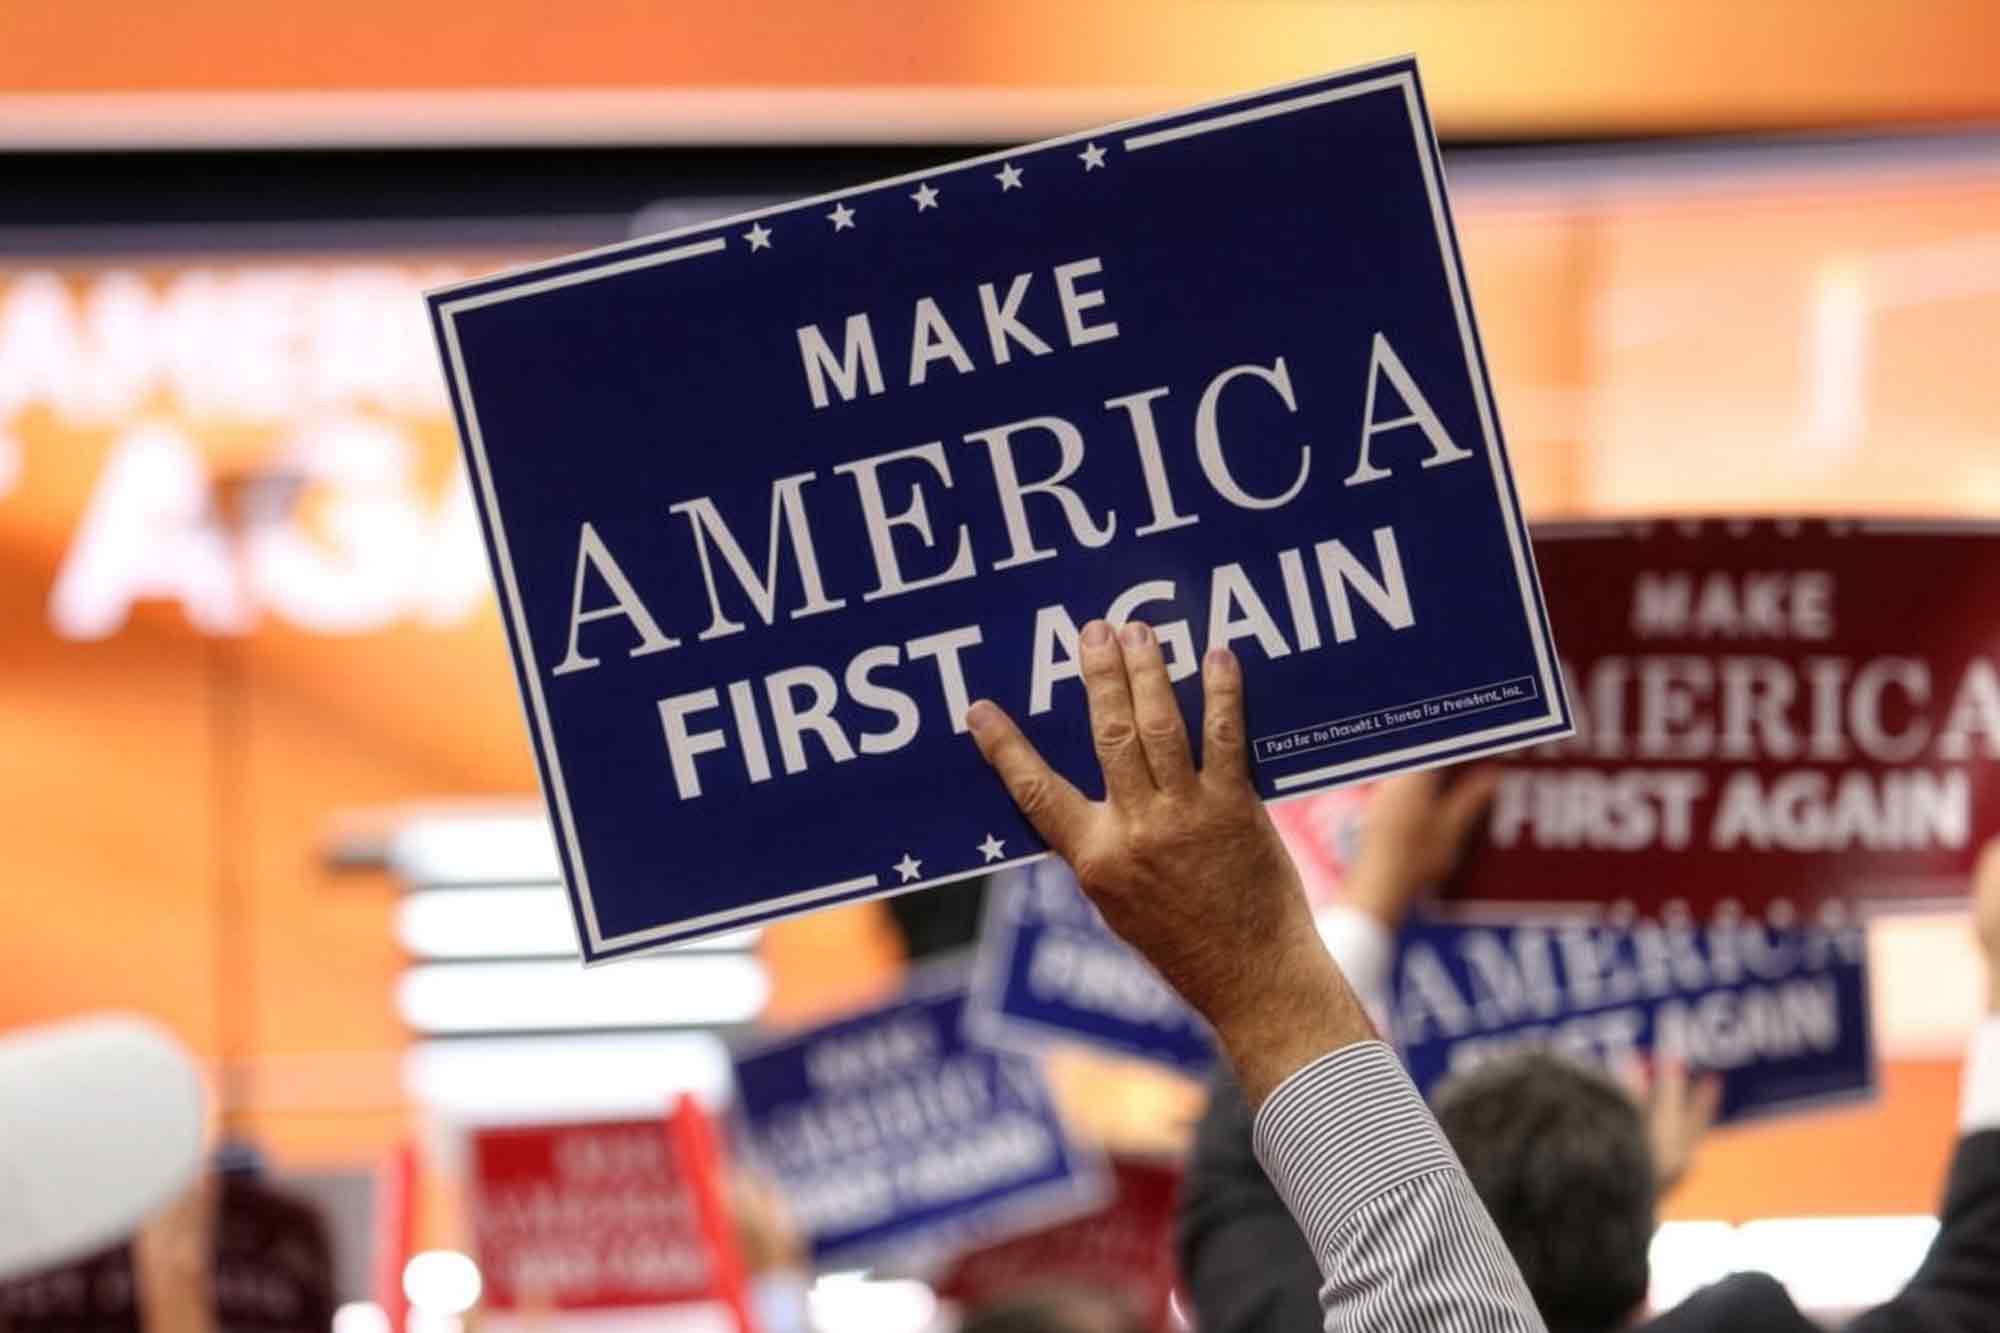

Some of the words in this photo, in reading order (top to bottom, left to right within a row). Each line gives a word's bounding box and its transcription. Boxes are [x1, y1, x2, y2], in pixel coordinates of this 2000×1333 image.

[798, 258, 1119, 408] MAKE
[553, 333, 1473, 676] AMERICA
[657, 625, 983, 800] FIRST
[1029, 526, 1415, 716] AGAIN
[1632, 570, 1834, 640] MAKE
[1530, 654, 2000, 762] MERICA
[1491, 766, 1704, 850] FIRST
[1710, 766, 1972, 850] AGAIN
